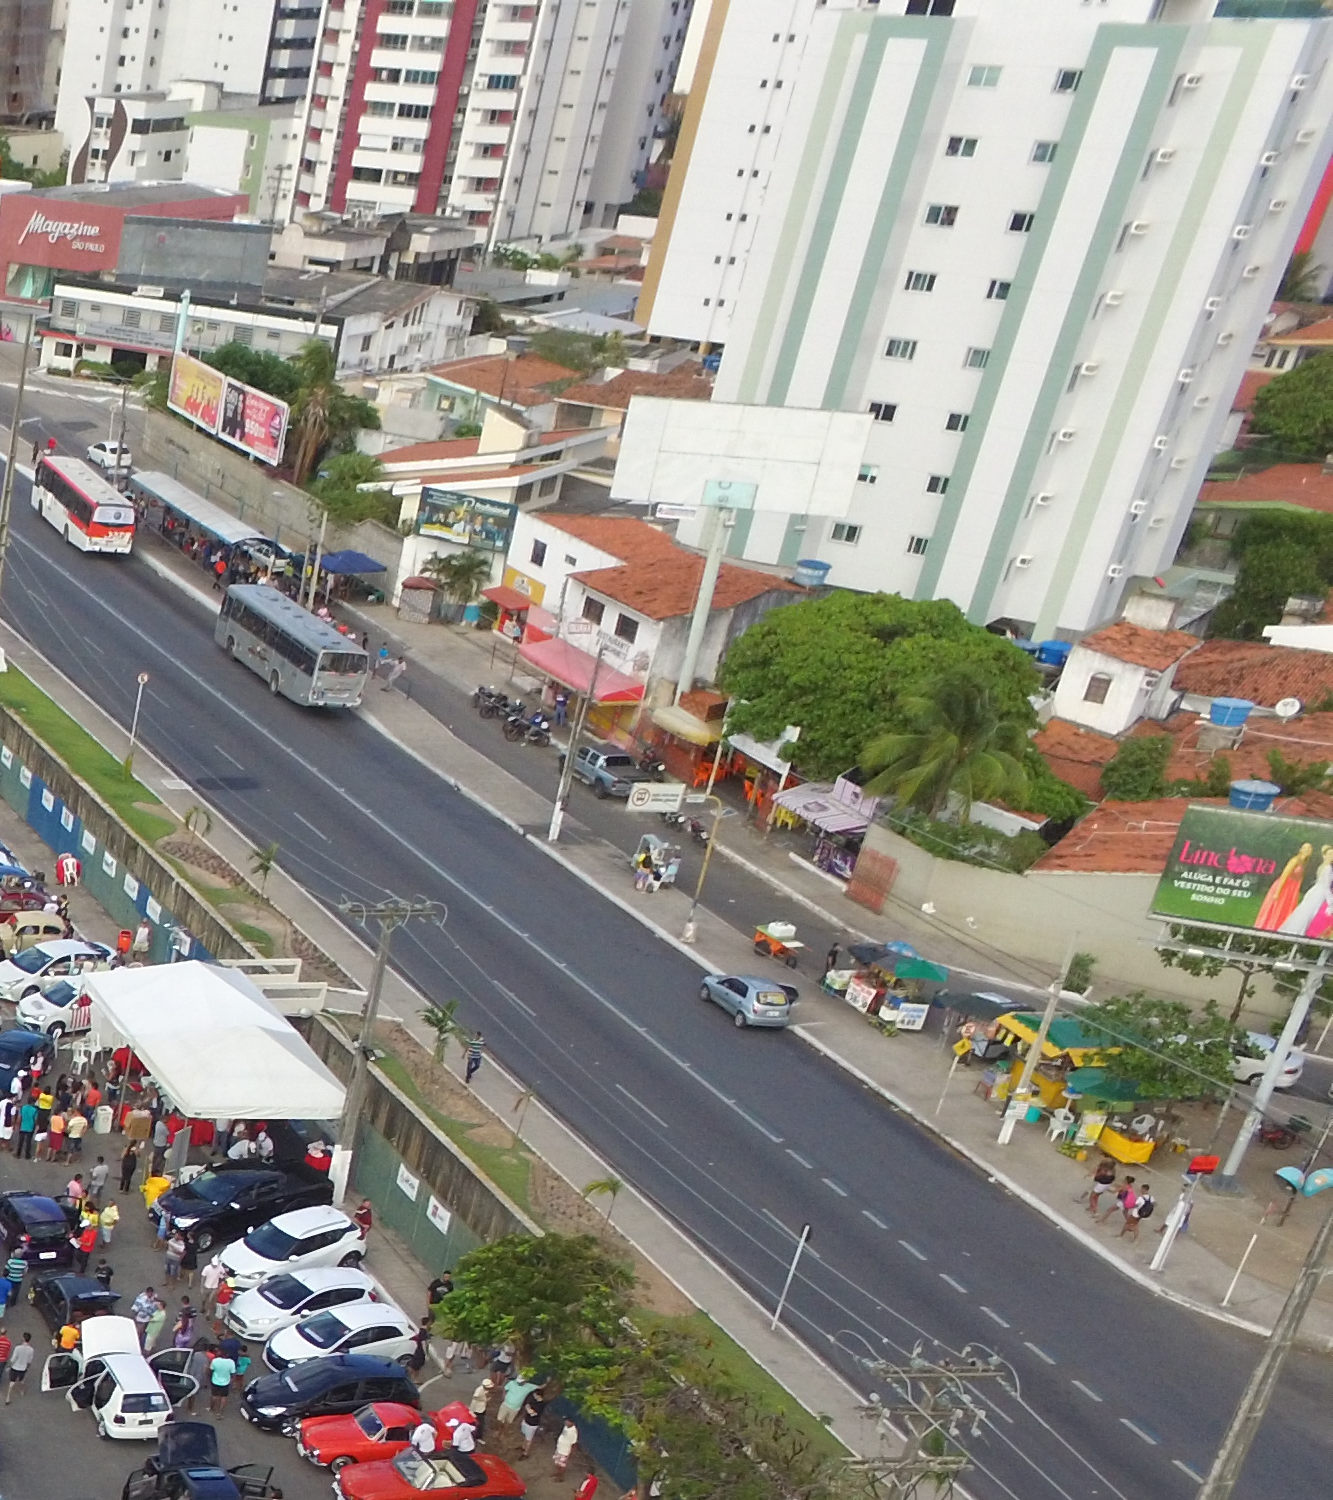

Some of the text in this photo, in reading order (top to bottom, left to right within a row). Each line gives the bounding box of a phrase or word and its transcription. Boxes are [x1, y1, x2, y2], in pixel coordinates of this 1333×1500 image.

[18, 209, 101, 244] Magazine
[71, 239, 105, 253] SÃO PAULO
[1180, 871, 1213, 883] ALUGA
[1222, 877, 1242, 888] FAZ
[1241, 880, 1251, 888] O
[1174, 879, 1252, 899] VESTIDO DO SEU
